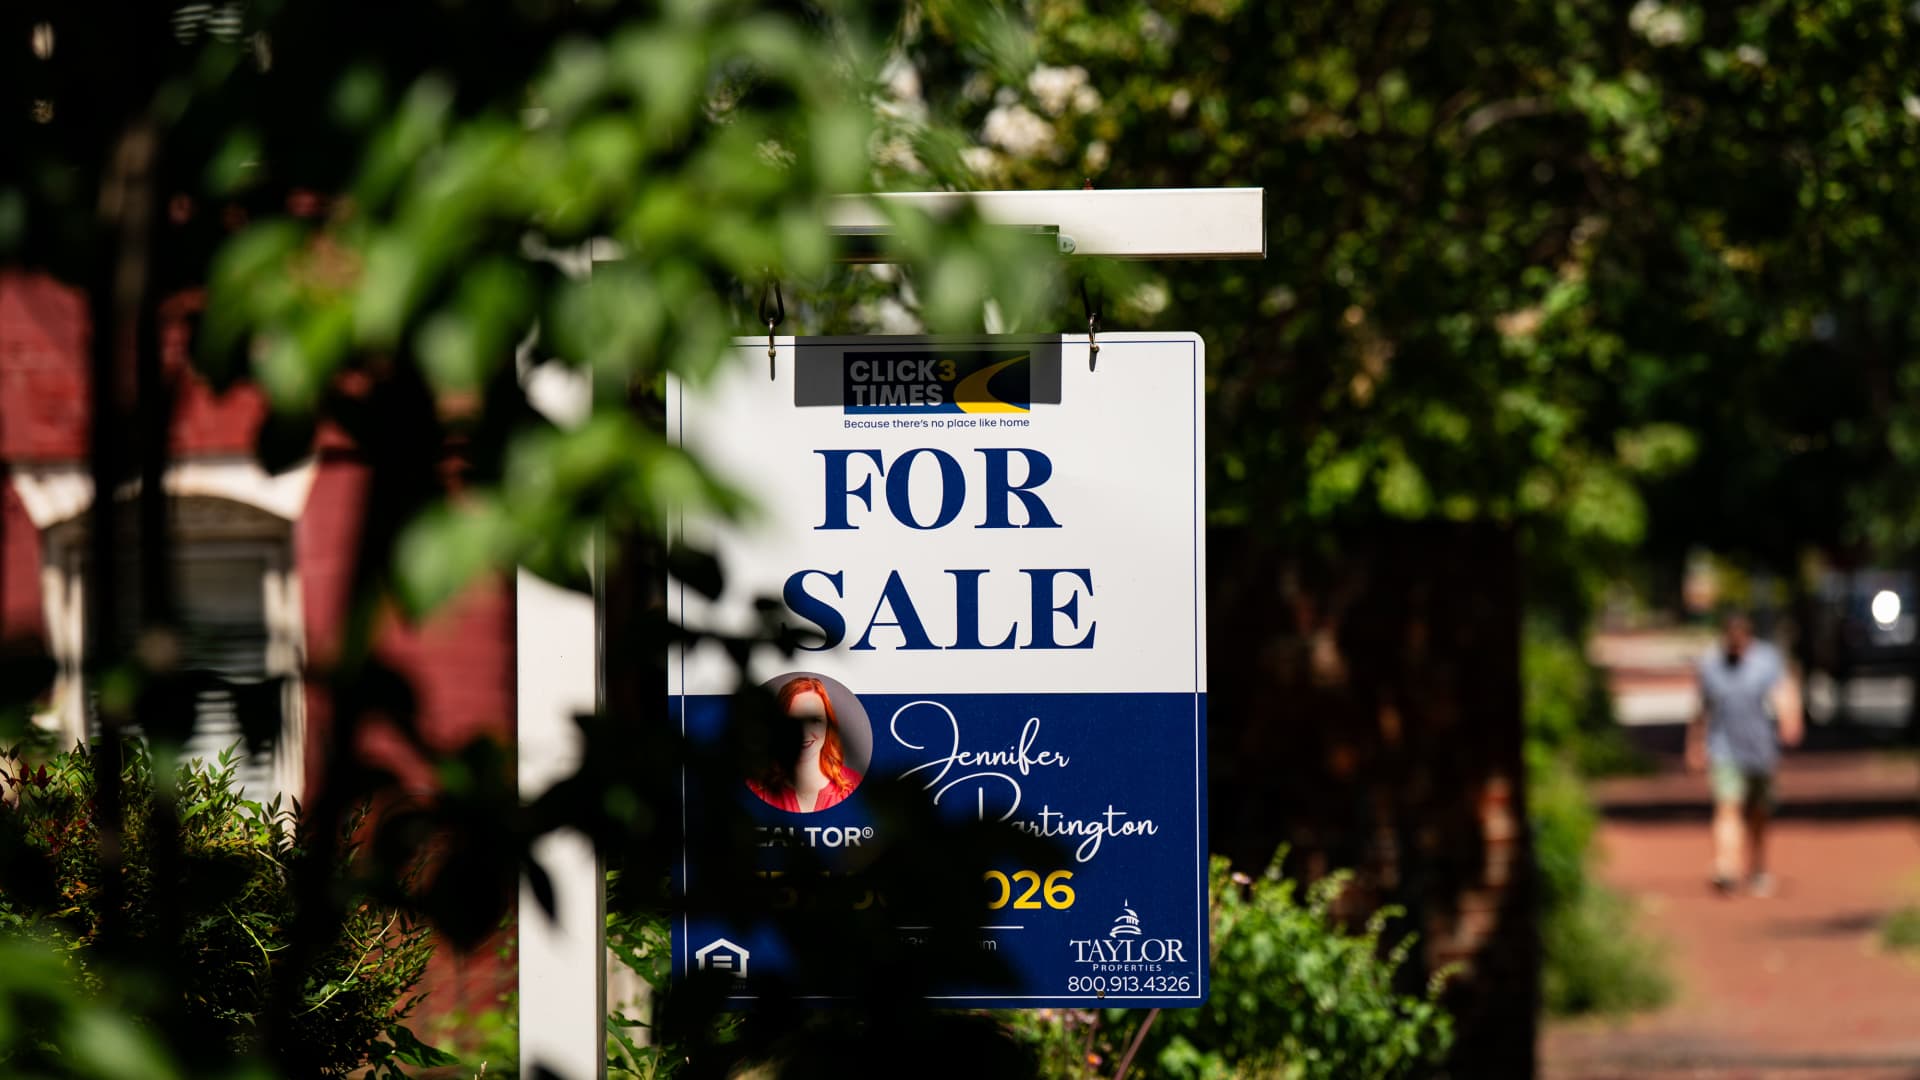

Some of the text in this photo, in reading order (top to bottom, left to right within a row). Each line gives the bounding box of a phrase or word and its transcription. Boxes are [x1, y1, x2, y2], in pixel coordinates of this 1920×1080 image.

[852, 384, 944, 407] TIMES
[844, 418, 1030, 430] Because there's no place like home
[813, 447, 1063, 530] FOR
[782, 568, 1097, 652] SALE
[890, 700, 1070, 789] Jennifer
[1069, 938, 1188, 963] TAYLOR
[1067, 975, 1191, 992] 800.913.4326
